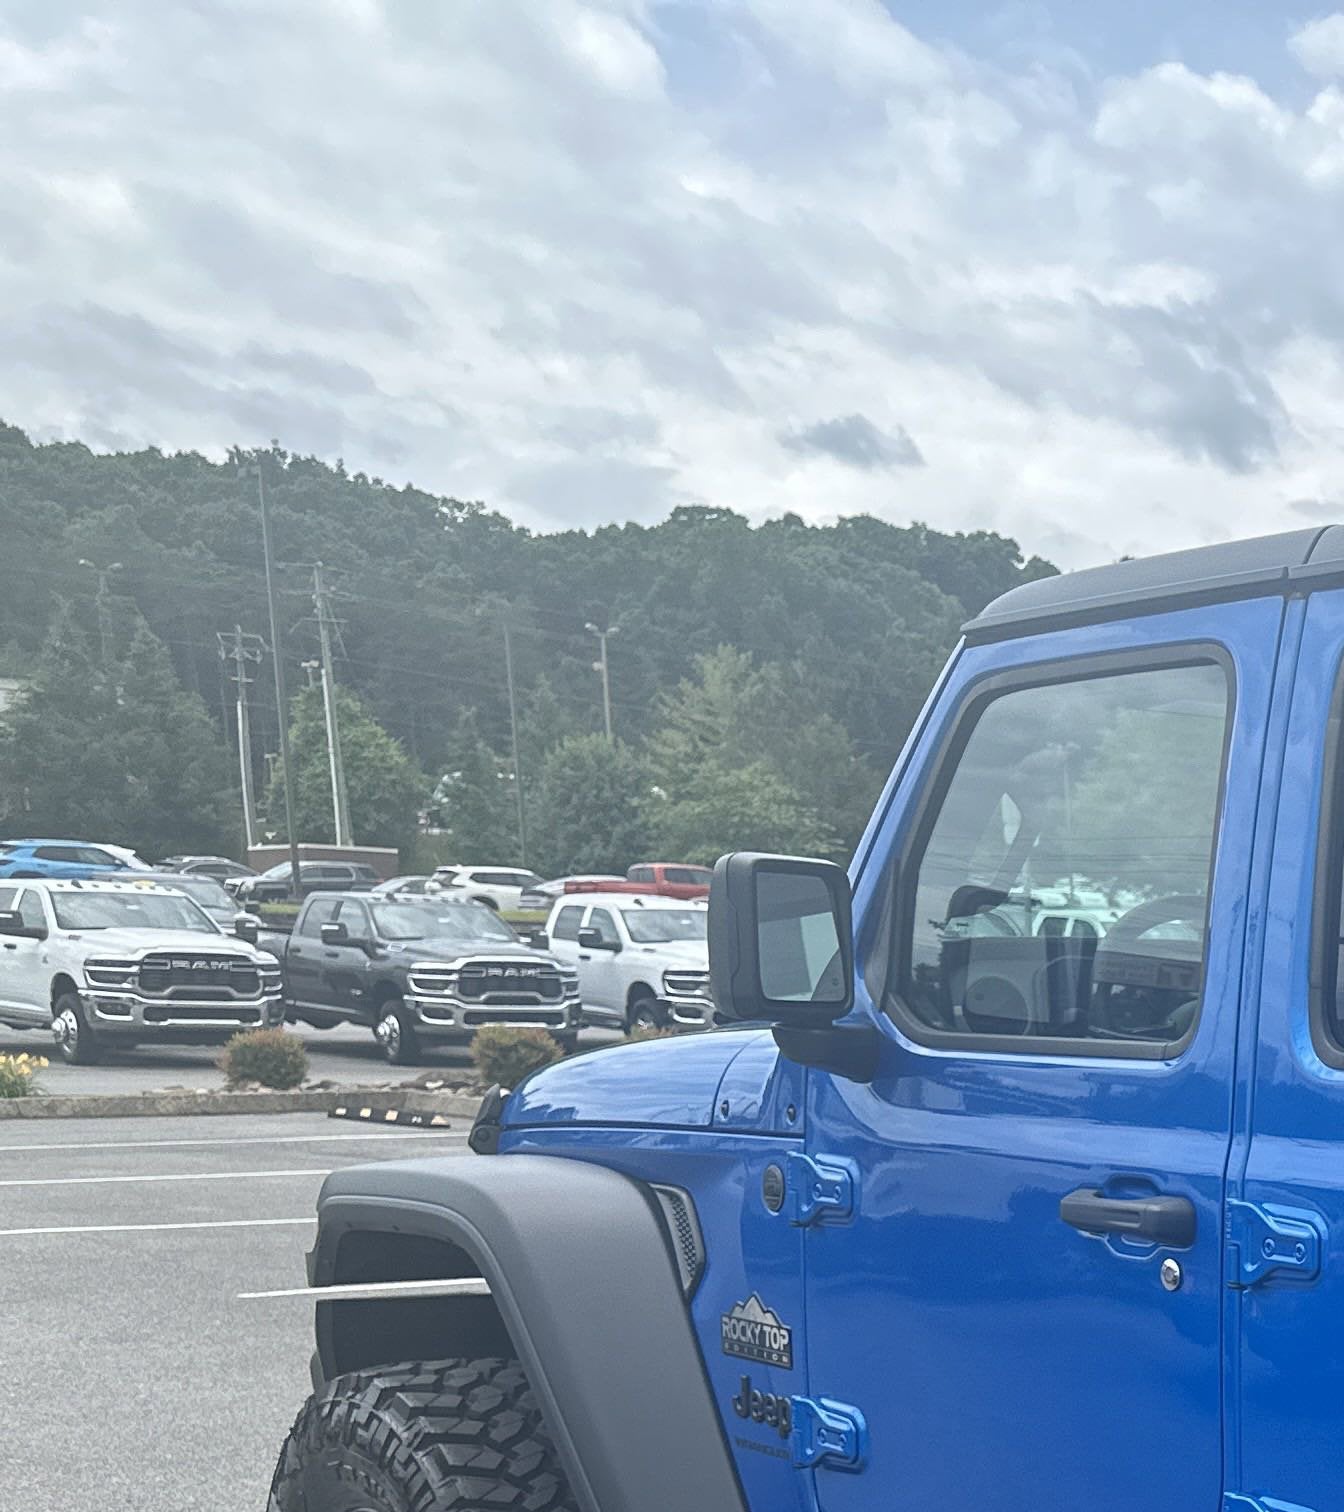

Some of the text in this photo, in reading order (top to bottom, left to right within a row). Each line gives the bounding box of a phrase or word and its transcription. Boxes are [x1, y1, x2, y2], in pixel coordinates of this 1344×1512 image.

[172, 960, 233, 970] RAM
[487, 967, 539, 978] RAM
[722, 1316, 789, 1351] ROCKY TOP
[733, 1375, 792, 1439] Jeep
